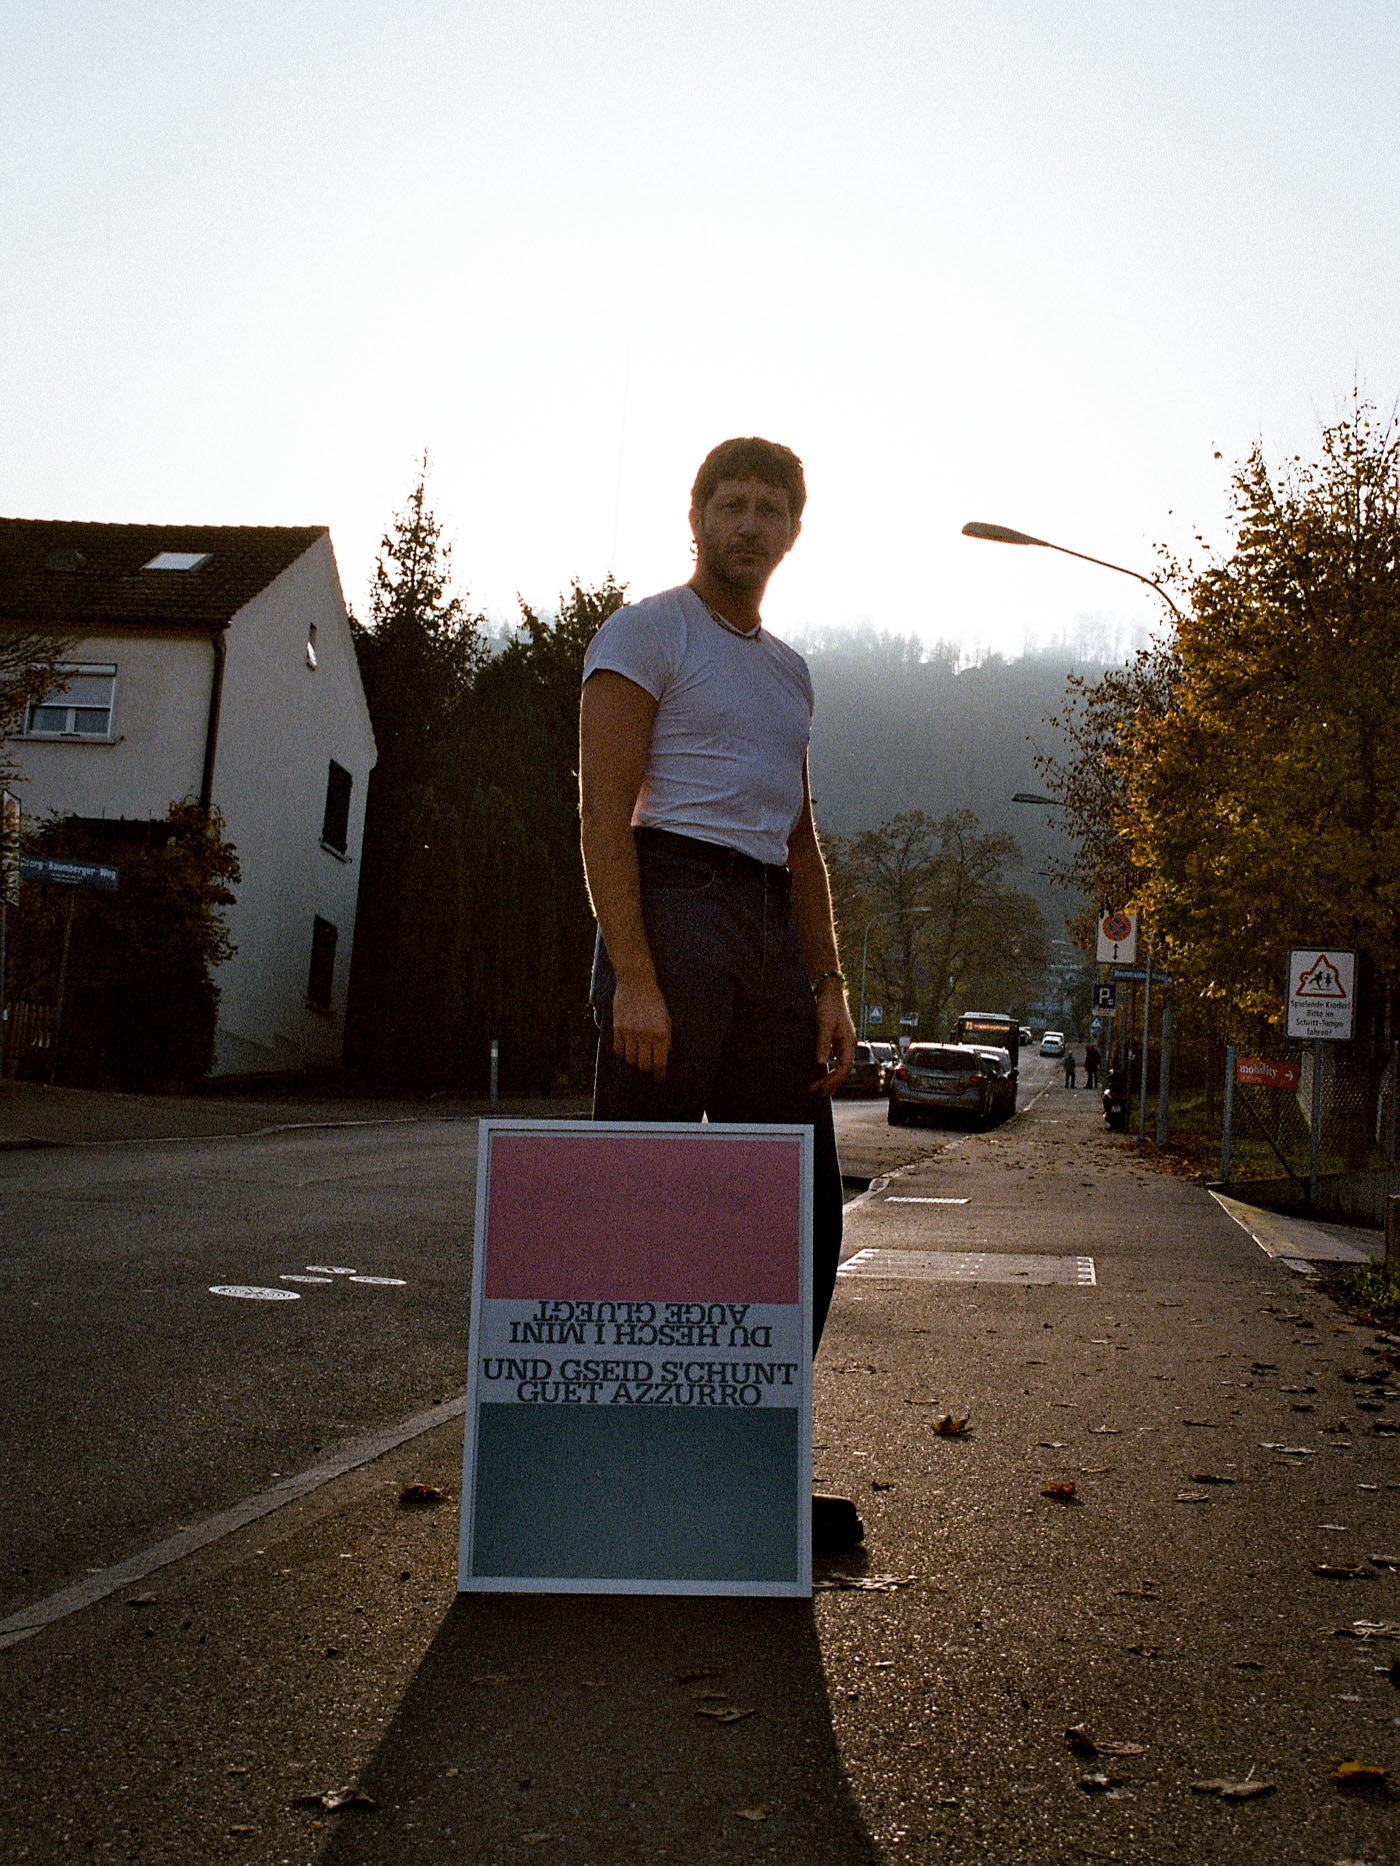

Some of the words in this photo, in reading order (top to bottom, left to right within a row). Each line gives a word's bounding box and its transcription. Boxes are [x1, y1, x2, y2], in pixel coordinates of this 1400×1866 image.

[533, 1300, 656, 1324] GLUEGT
[665, 1303, 750, 1325] AUGE
[509, 1322, 585, 1344] MINI
[595, 1323, 605, 1344] I
[615, 1323, 719, 1347] HESCH
[728, 1326, 772, 1347] DU
[482, 1358, 552, 1381] UND
[560, 1359, 654, 1382] GSEID
[661, 1361, 798, 1385] S'CHUNT
[517, 1382, 603, 1403] GUET
[612, 1383, 762, 1406] AZZURRO
